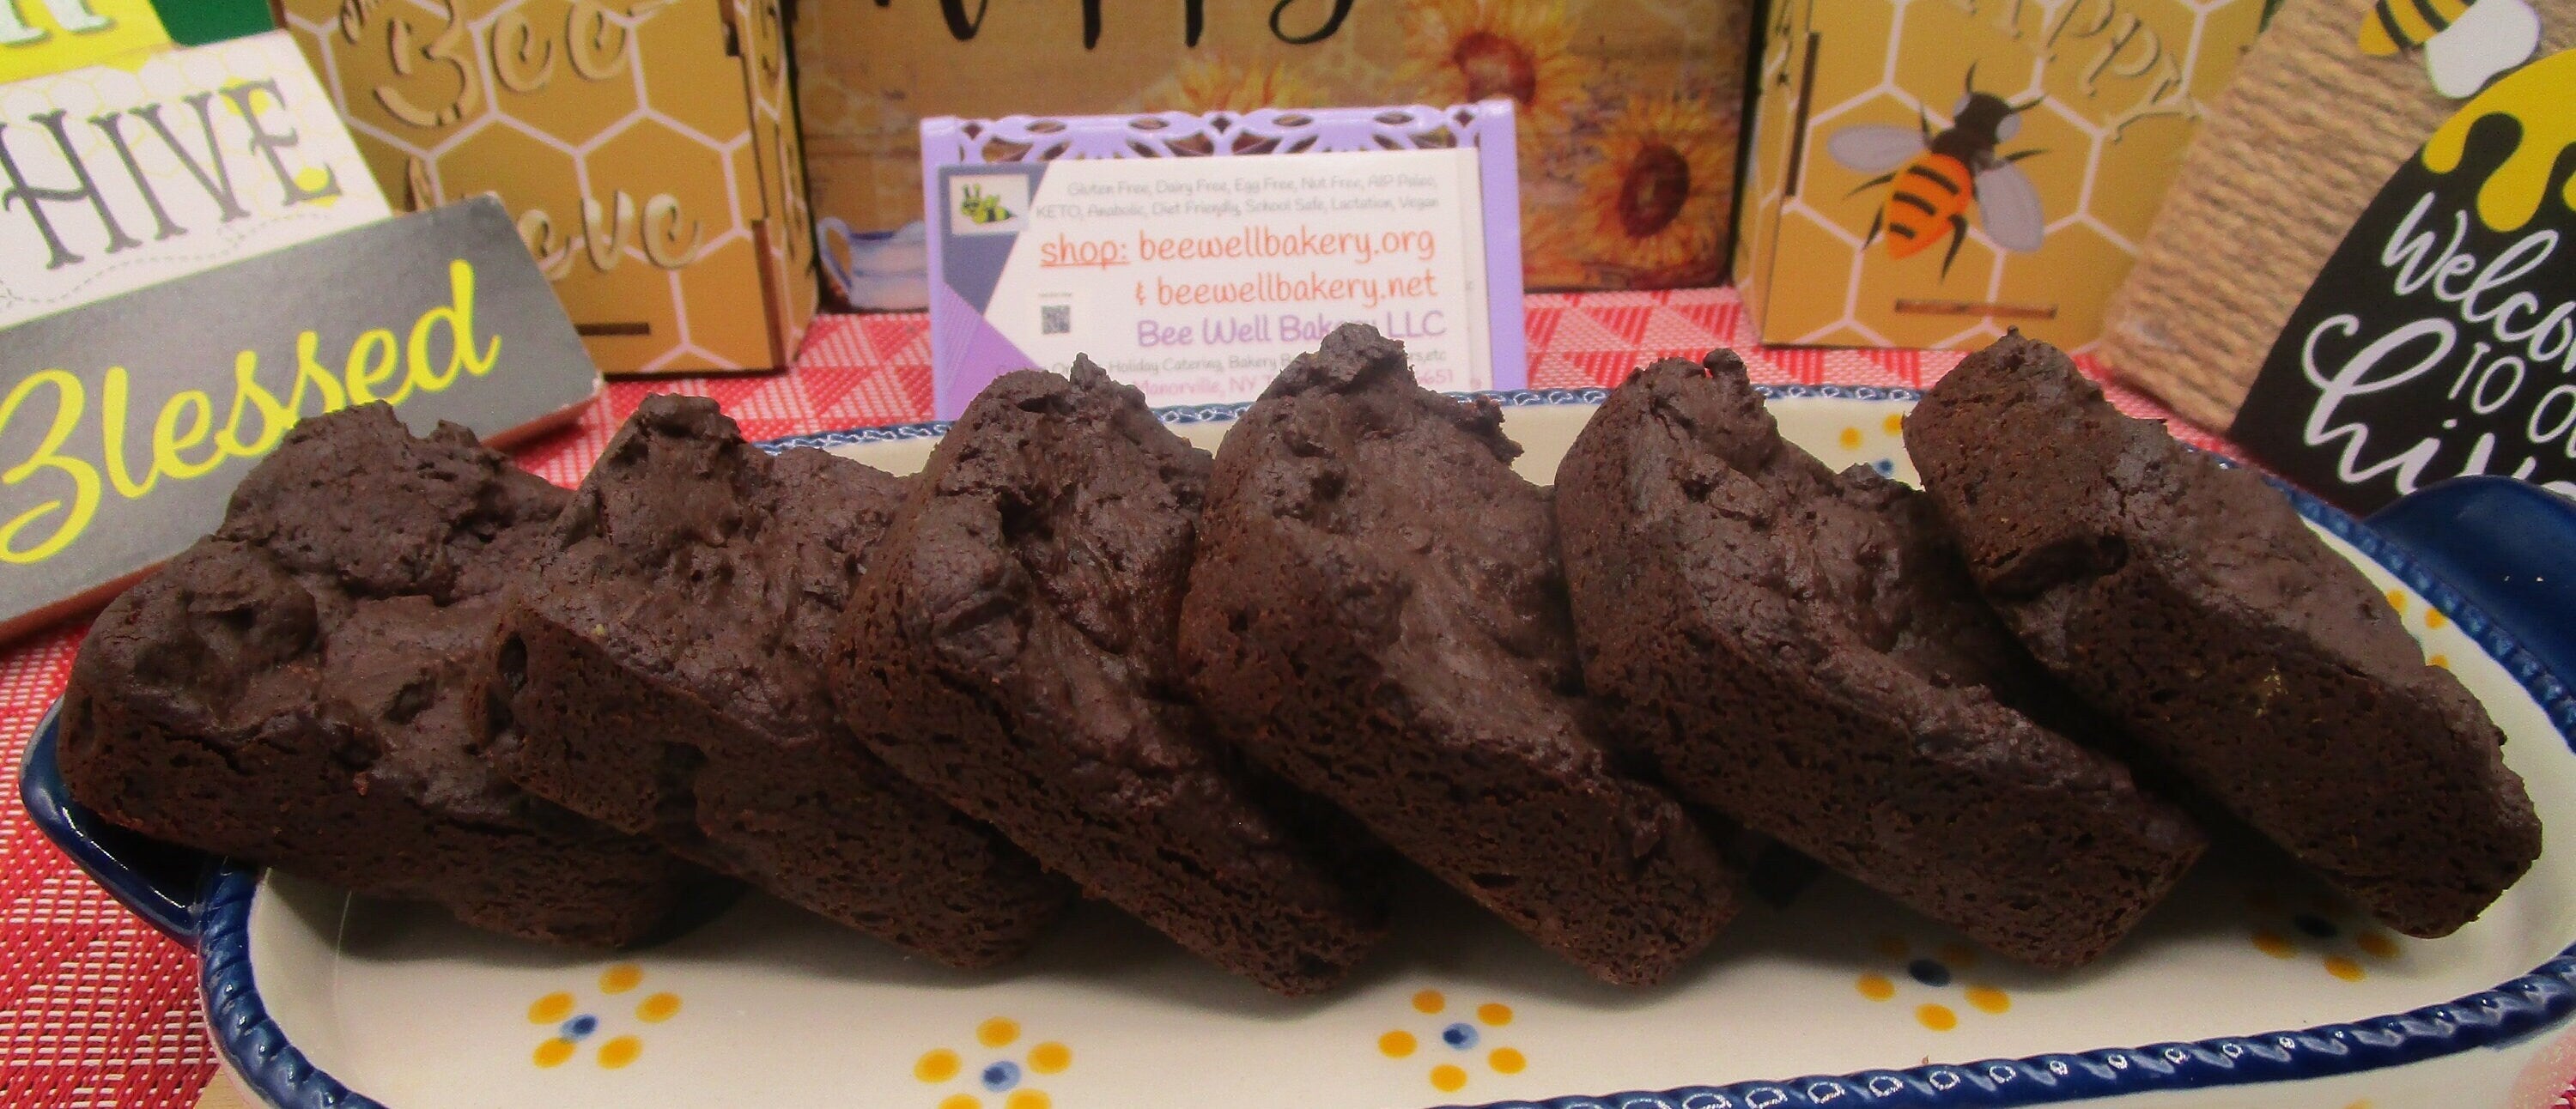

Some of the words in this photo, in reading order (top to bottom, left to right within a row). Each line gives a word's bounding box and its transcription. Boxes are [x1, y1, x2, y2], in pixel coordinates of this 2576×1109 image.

[0, 78, 343, 270] HIVE
[1067, 181, 1114, 196] Gluten
[1117, 180, 1151, 195] Free,
[1156, 179, 1193, 195] Dairy
[1196, 179, 1231, 193] Free,
[1235, 178, 1261, 194] Egg
[1264, 177, 1298, 192] Free,
[1302, 177, 1327, 190] Nut
[1036, 204, 1084, 220] KETO,
[1151, 201, 1181, 215] Diet
[1246, 198, 1291, 212] School
[1400, 196, 1440, 211] Vegan
[1040, 232, 1131, 270] shop:
[1139, 225, 1437, 264] beewellbakery.org
[1157, 269, 1439, 309] beewellbakery.net
[2380, 191, 2576, 374] Welco
[1136, 319, 1194, 348] Bee
[1201, 314, 1273, 345] Well
[1386, 309, 1449, 340] LLC
[1109, 358, 1159, 375] Holiday
[1228, 355, 1278, 371] Bakery
[1229, 376, 1256, 393] NY
[0, 259, 501, 565] Blessed
